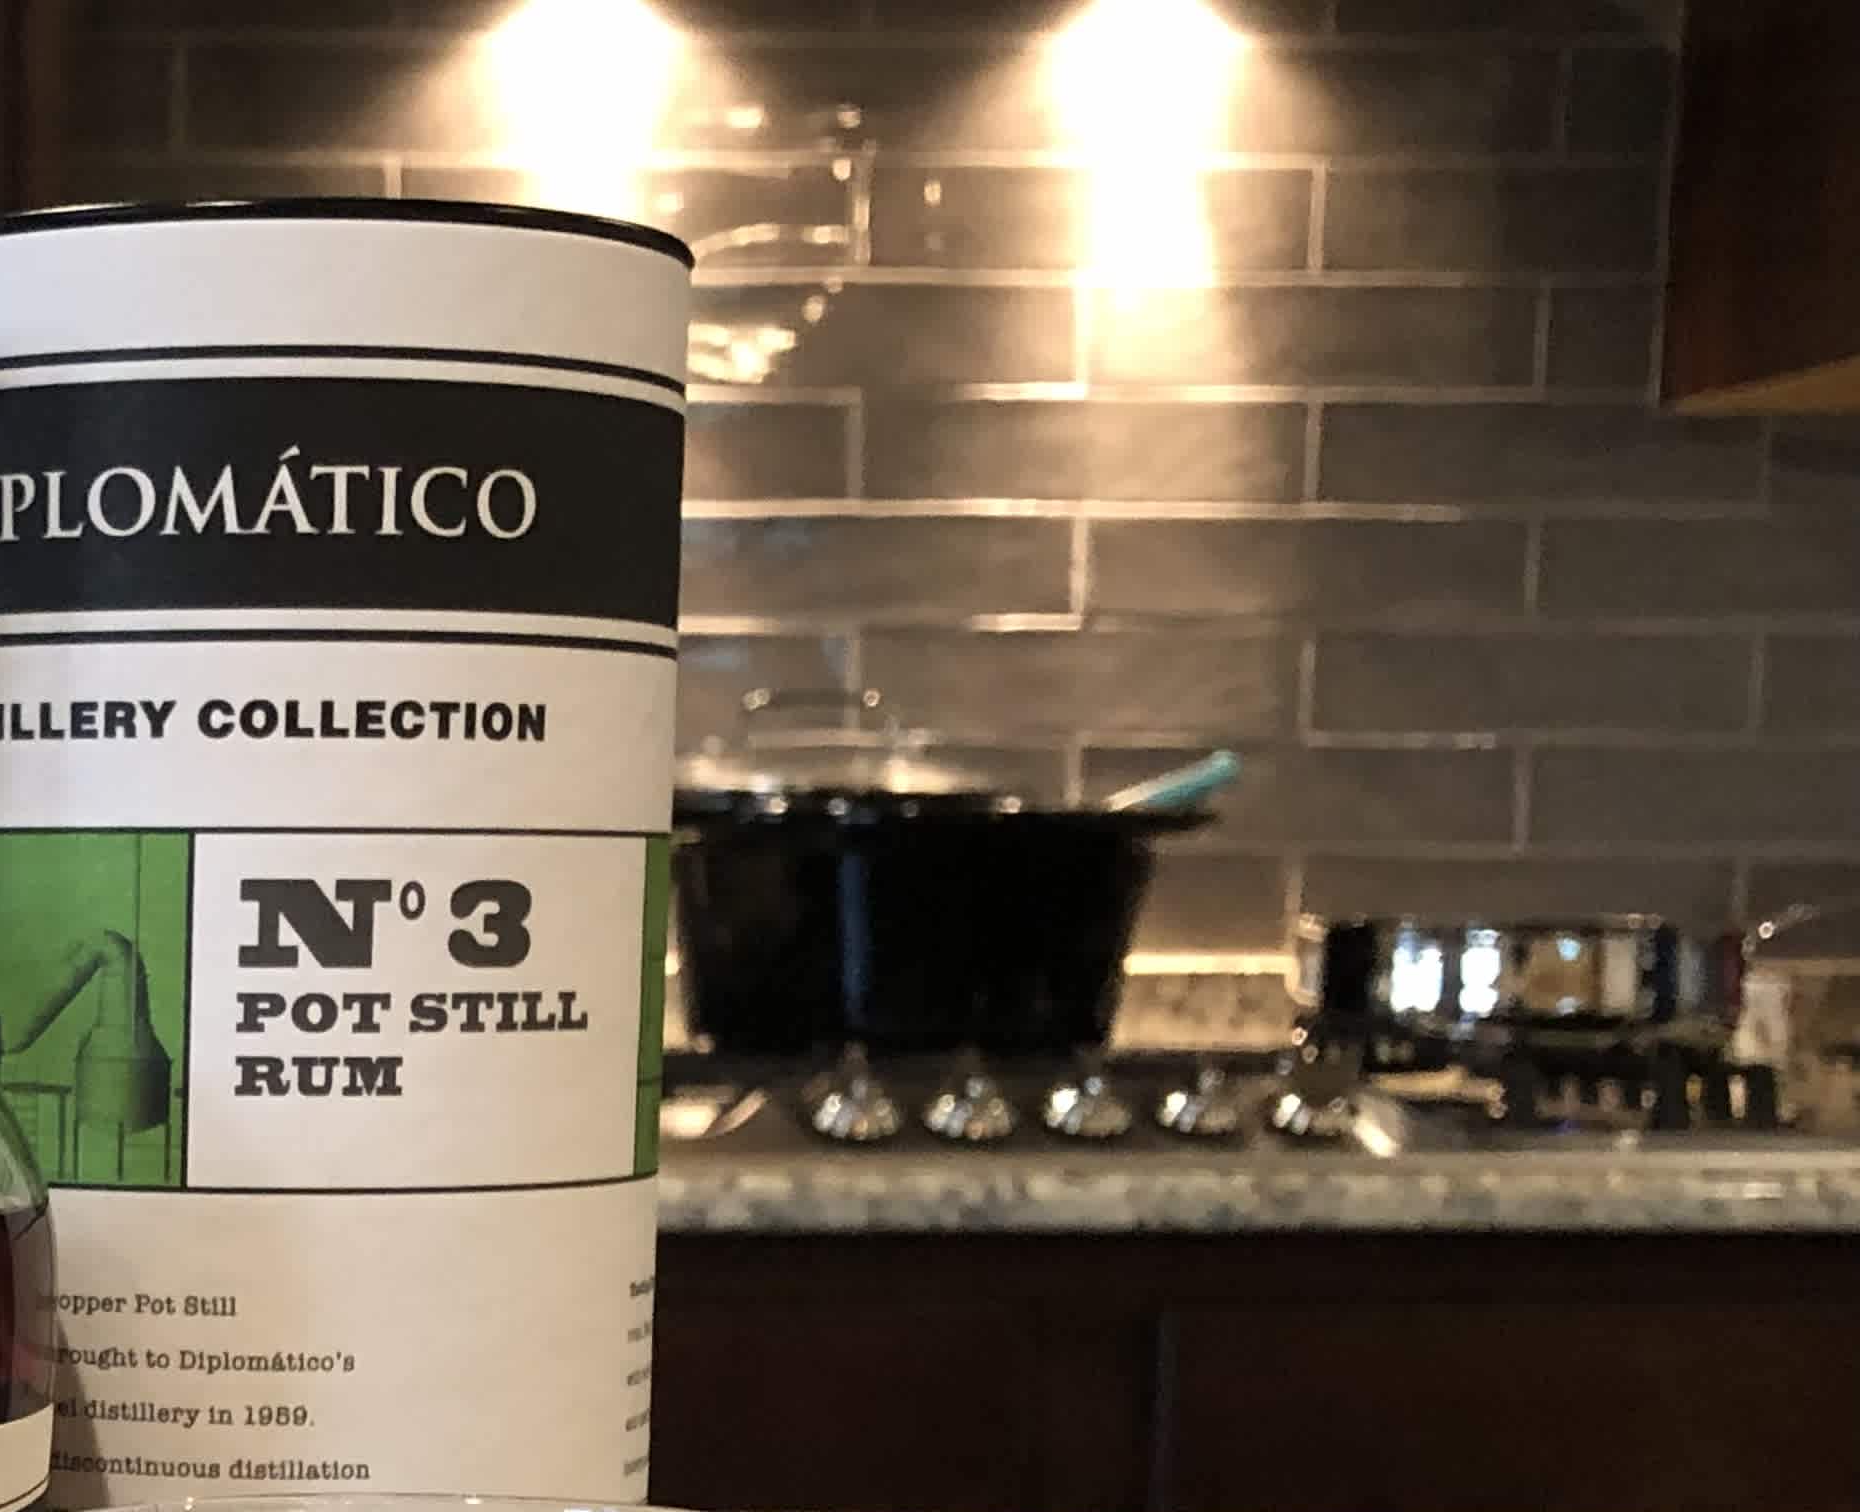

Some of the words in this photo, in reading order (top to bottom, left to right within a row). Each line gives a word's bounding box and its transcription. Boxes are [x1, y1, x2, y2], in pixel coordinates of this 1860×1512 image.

[197, 699, 546, 743] COLLECTION
[446, 879, 533, 969] 3
[235, 991, 391, 1034] POT
[408, 990, 588, 1034] STILL
[234, 1055, 404, 1097] RUM
[57, 1294, 128, 1317] opper
[134, 1292, 177, 1317] Pot
[182, 1294, 239, 1317] Still
[57, 1346, 139, 1371] rought
[145, 1350, 171, 1370] to
[178, 1349, 357, 1375] Diplomático's
[83, 1399, 200, 1429] distillery
[207, 1403, 234, 1427] in
[228, 1457, 371, 1481] distillation
